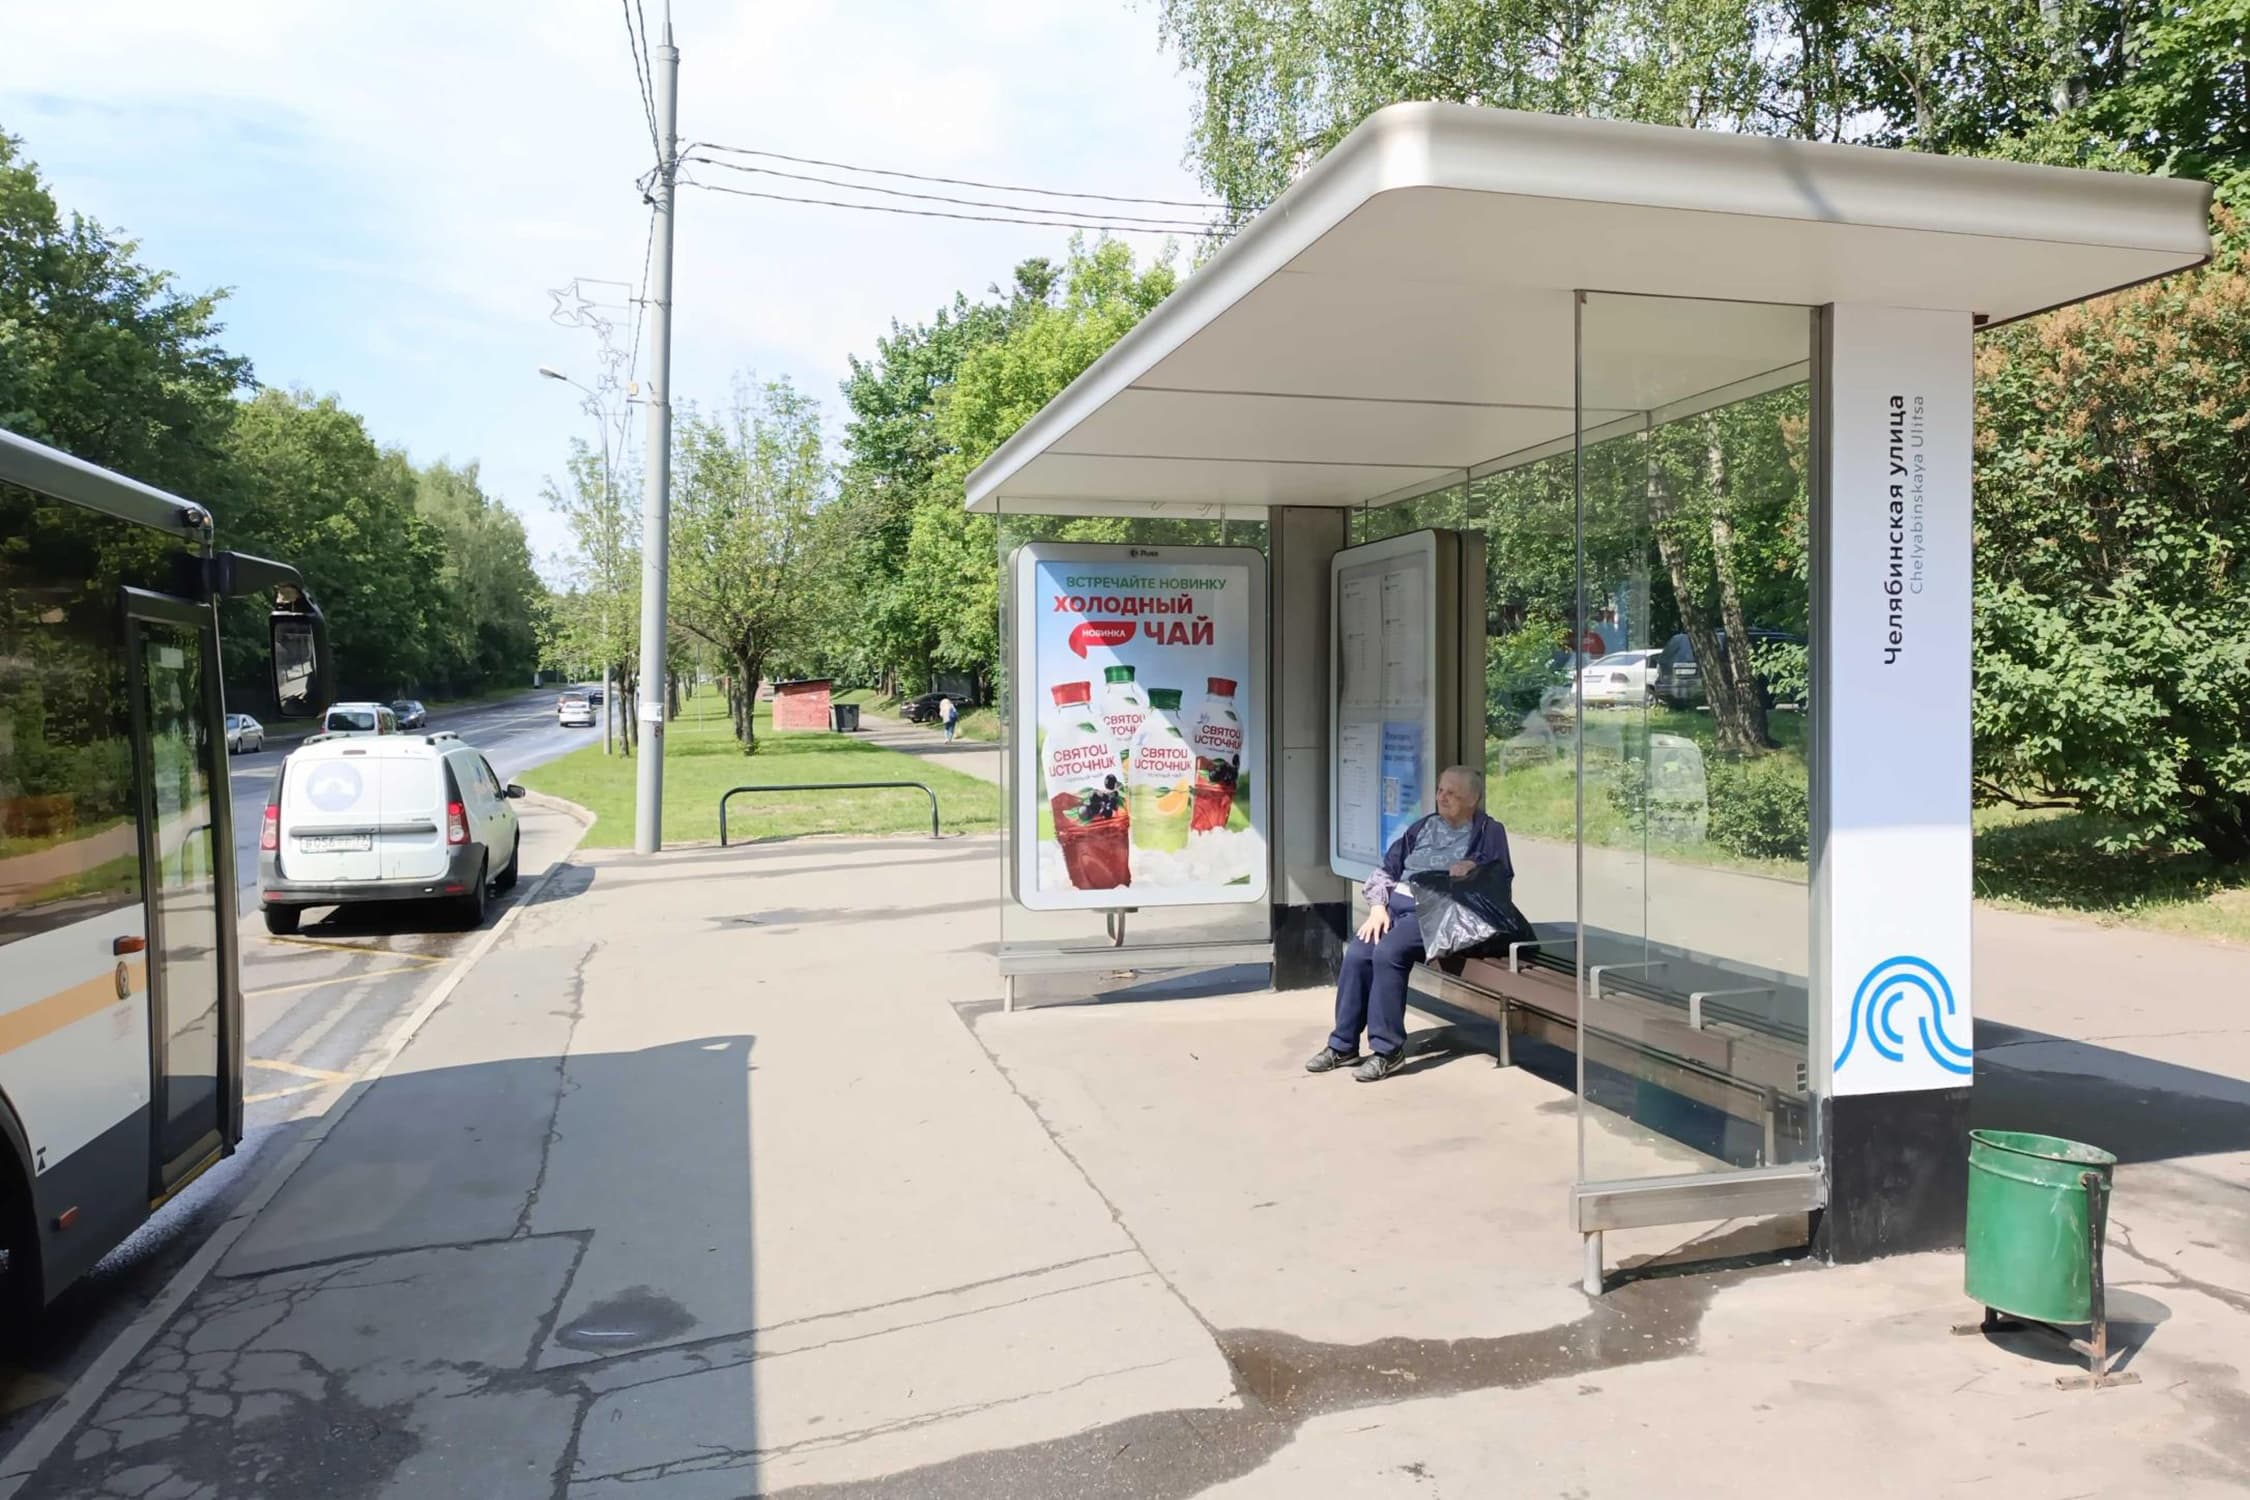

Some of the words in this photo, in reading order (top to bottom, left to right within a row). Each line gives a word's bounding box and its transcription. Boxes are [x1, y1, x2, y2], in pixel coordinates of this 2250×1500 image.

[1889, 394, 1908, 475] улица
[1910, 396, 1924, 448] Ulitsa
[1910, 453, 1926, 594] Chelyabinskaya
[1066, 575, 1155, 589] ВСТРЕЧАЙТЕ
[1159, 577, 1227, 590] НОВИНКУ
[1884, 484, 1904, 665] Челябинская
[1054, 593, 1193, 616] ХОЛОДНЫЙ
[1082, 629, 1126, 638] НОВИНКА
[1143, 615, 1214, 645] ЧАЙ
